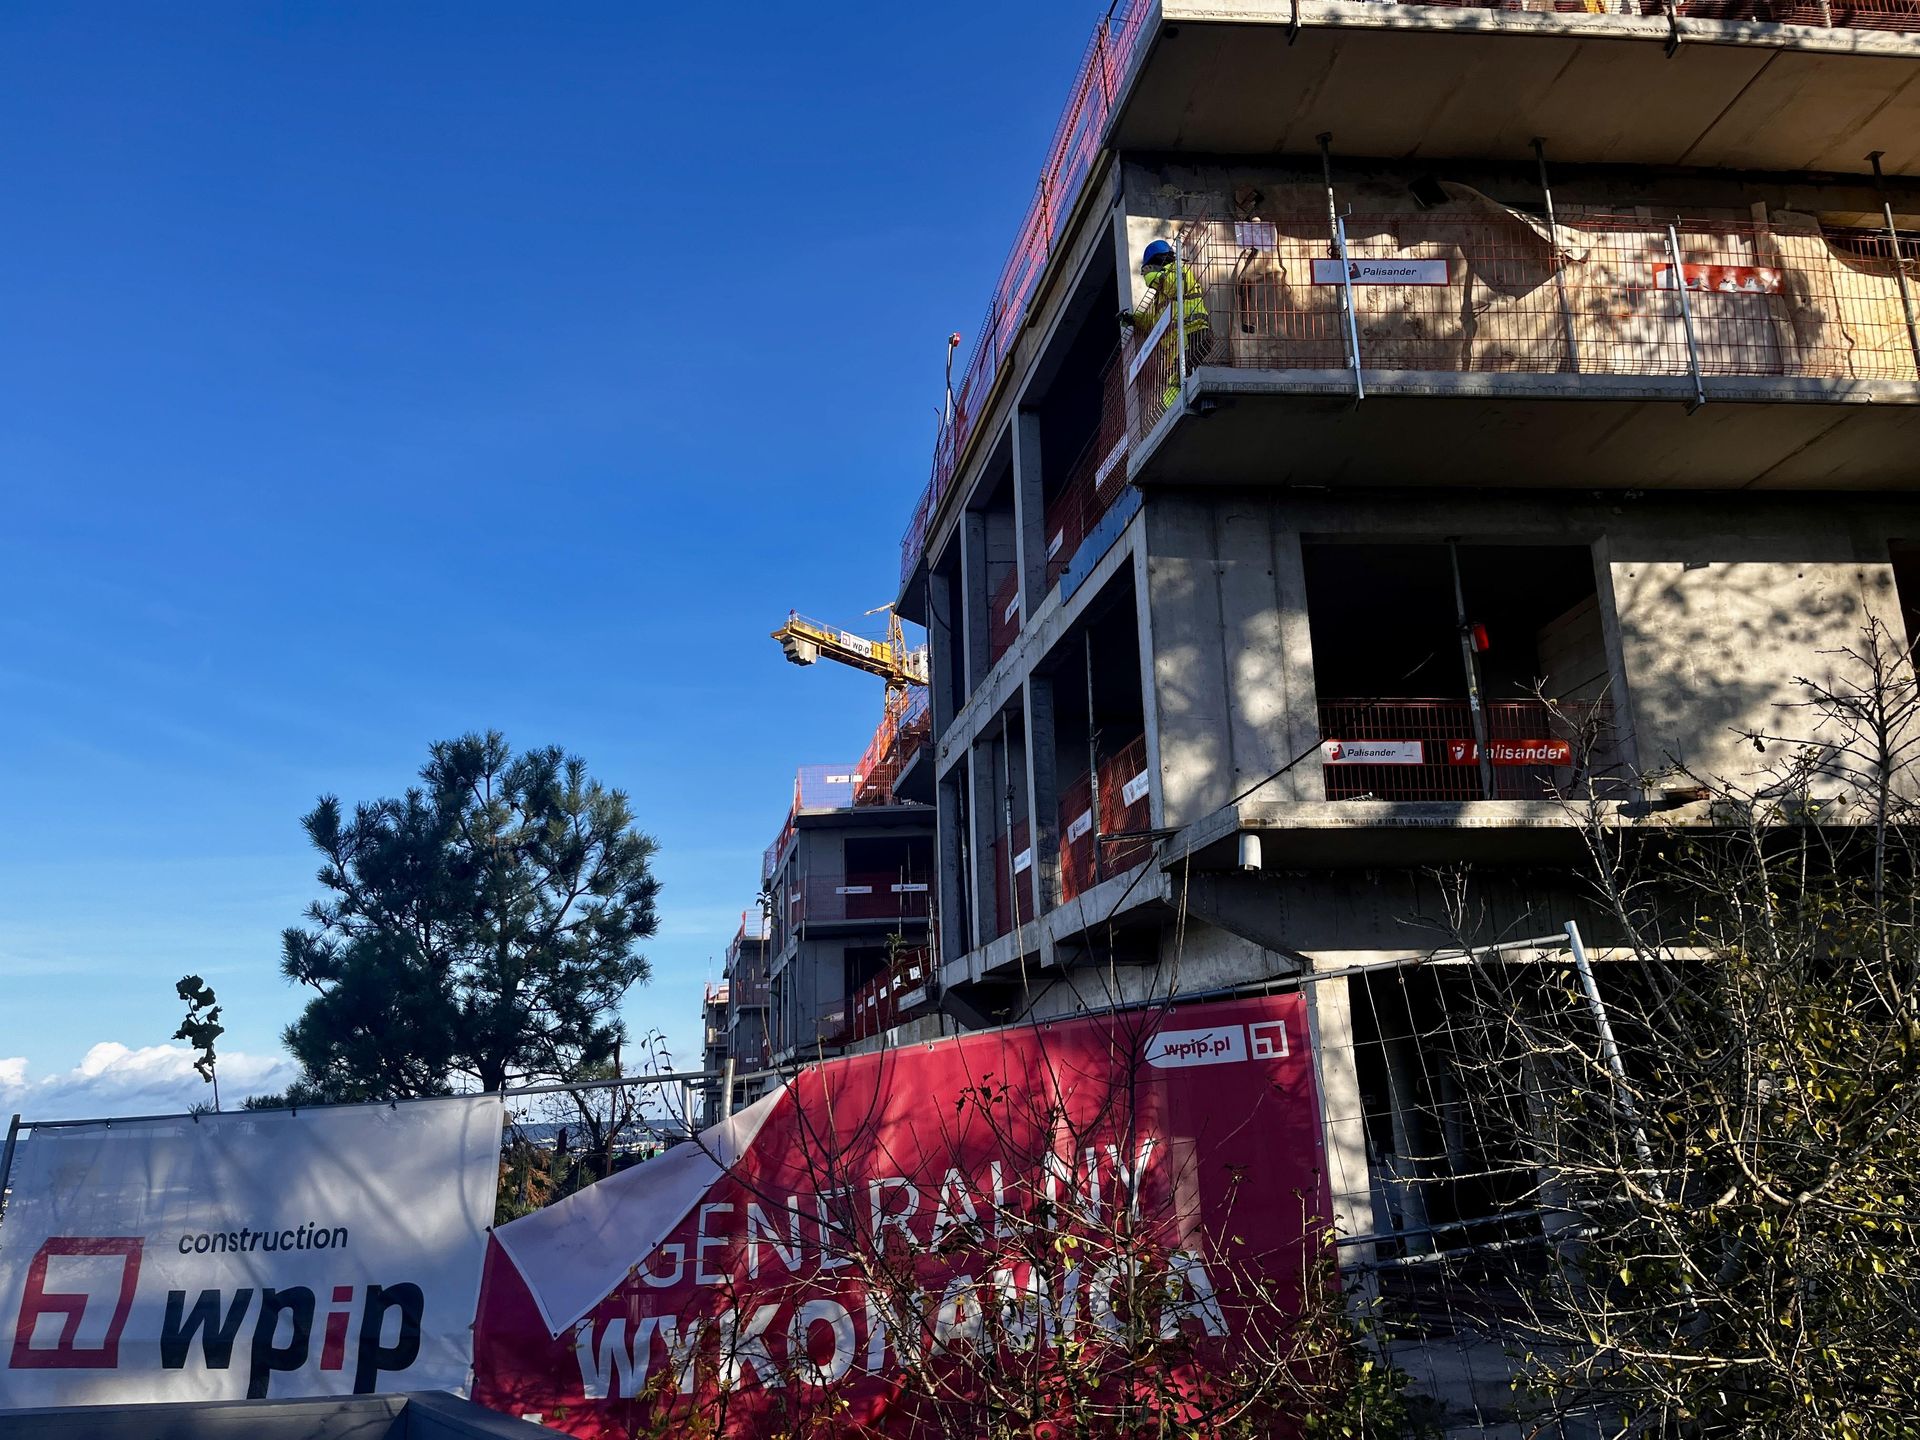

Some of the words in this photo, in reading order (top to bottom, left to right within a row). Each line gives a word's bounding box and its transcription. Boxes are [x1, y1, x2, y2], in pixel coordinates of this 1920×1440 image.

[1362, 267, 1417, 277] Palisander
[1347, 748, 1396, 757] Palisander
[1164, 1036, 1231, 1060] wpip.pl
[178, 1222, 348, 1255] construction
[160, 1281, 425, 1400] wpip
